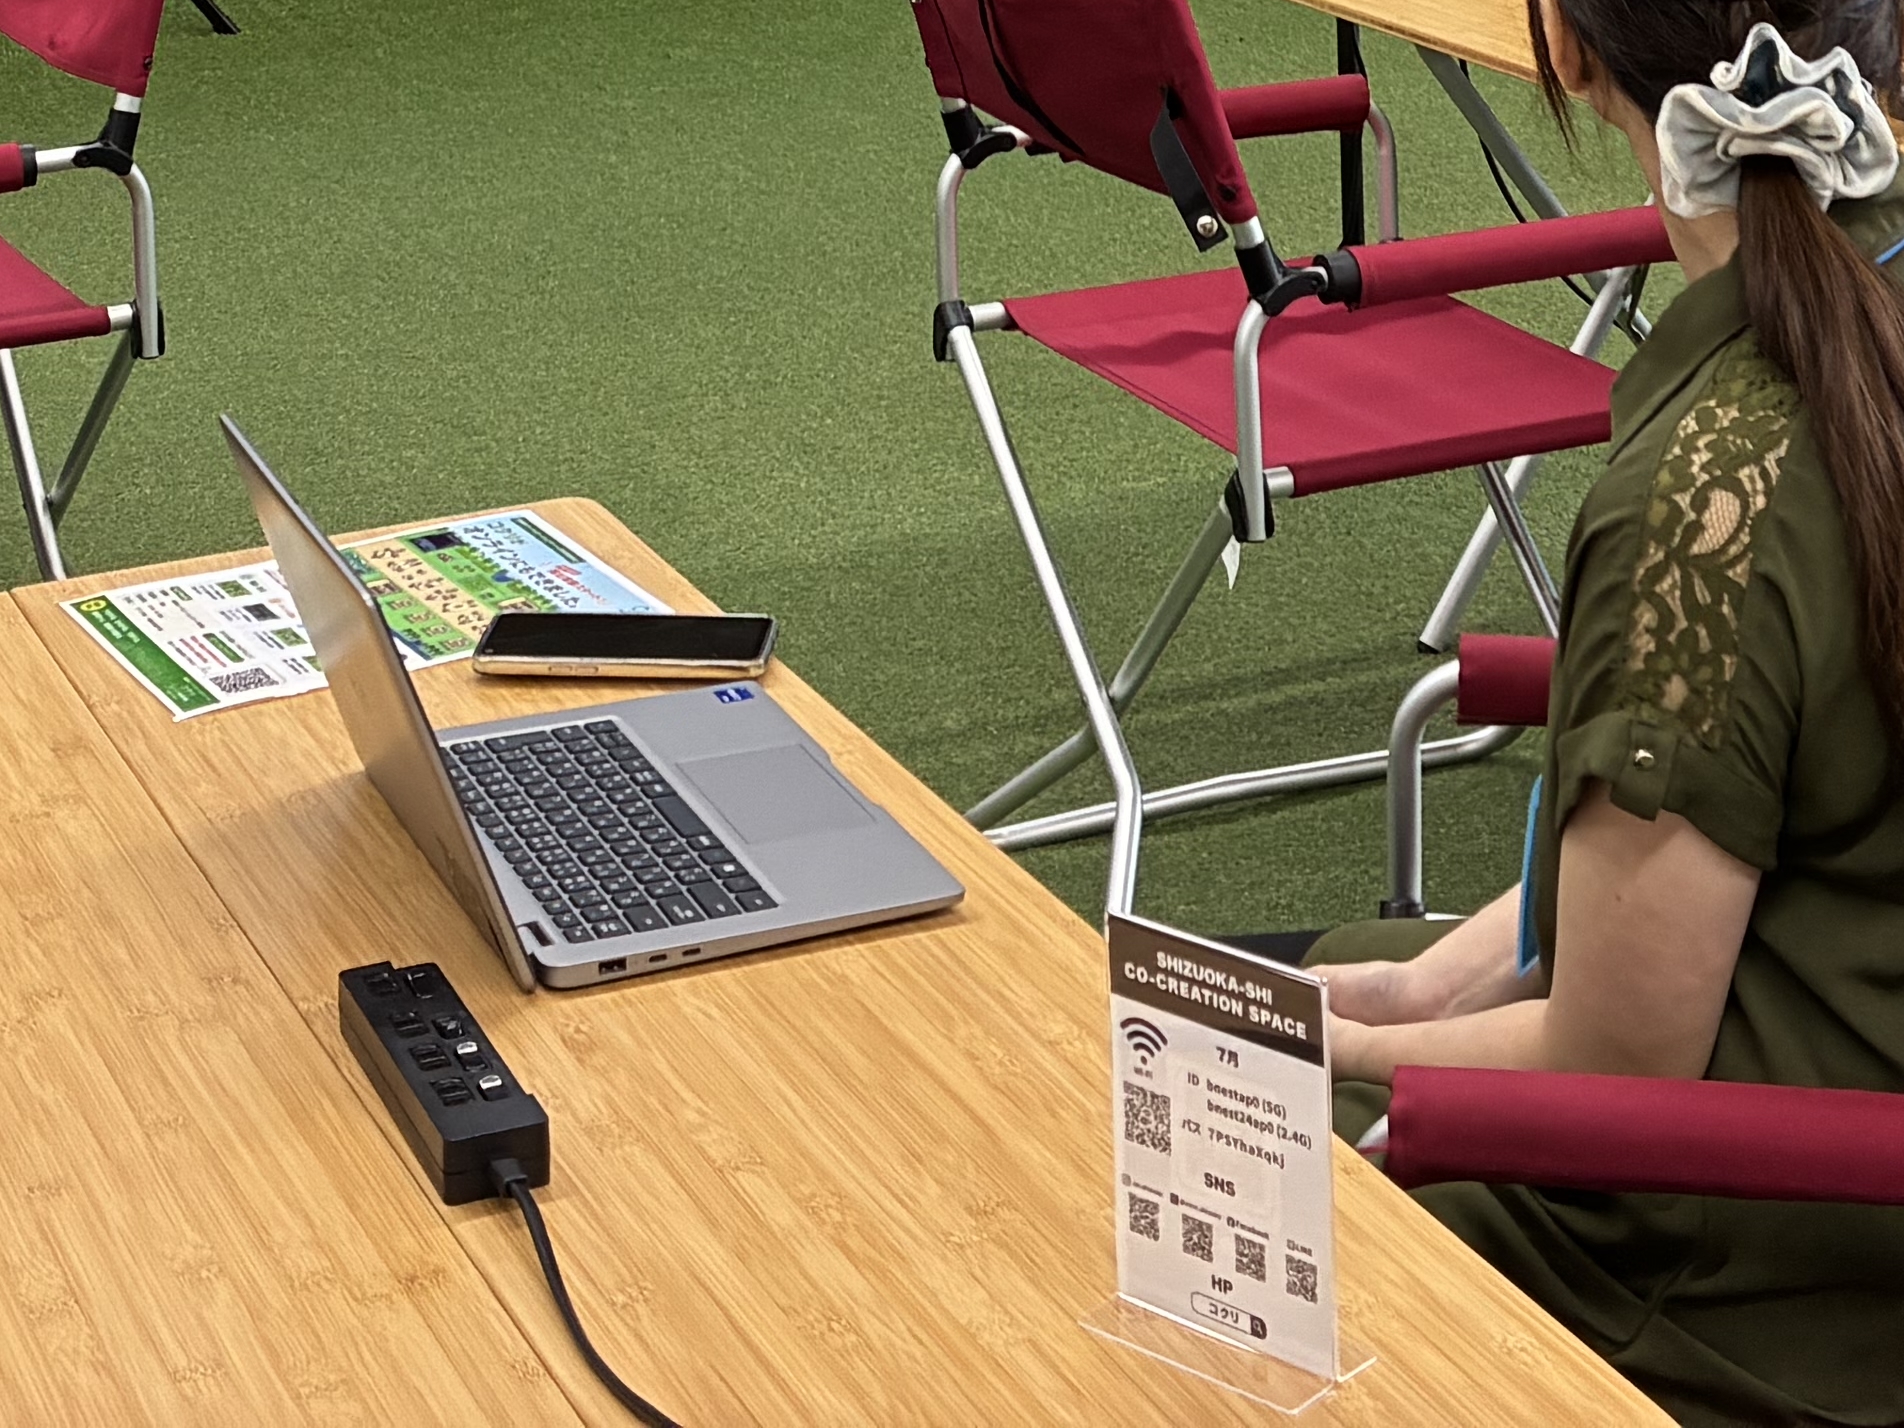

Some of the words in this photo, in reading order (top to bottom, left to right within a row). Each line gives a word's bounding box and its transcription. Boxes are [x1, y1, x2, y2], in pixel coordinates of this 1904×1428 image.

[1156, 950, 1273, 1007] SHIZUOKA-SHI
[1124, 961, 1244, 1017] CO-CREATION
[1248, 1004, 1308, 1040] SPACE
[1215, 1045, 1240, 1069] 7月
[1187, 1071, 1200, 1087] ID
[1203, 1171, 1236, 1198] SNS
[1210, 1273, 1234, 1294] HP
[1208, 1302, 1240, 1325] コクリ
